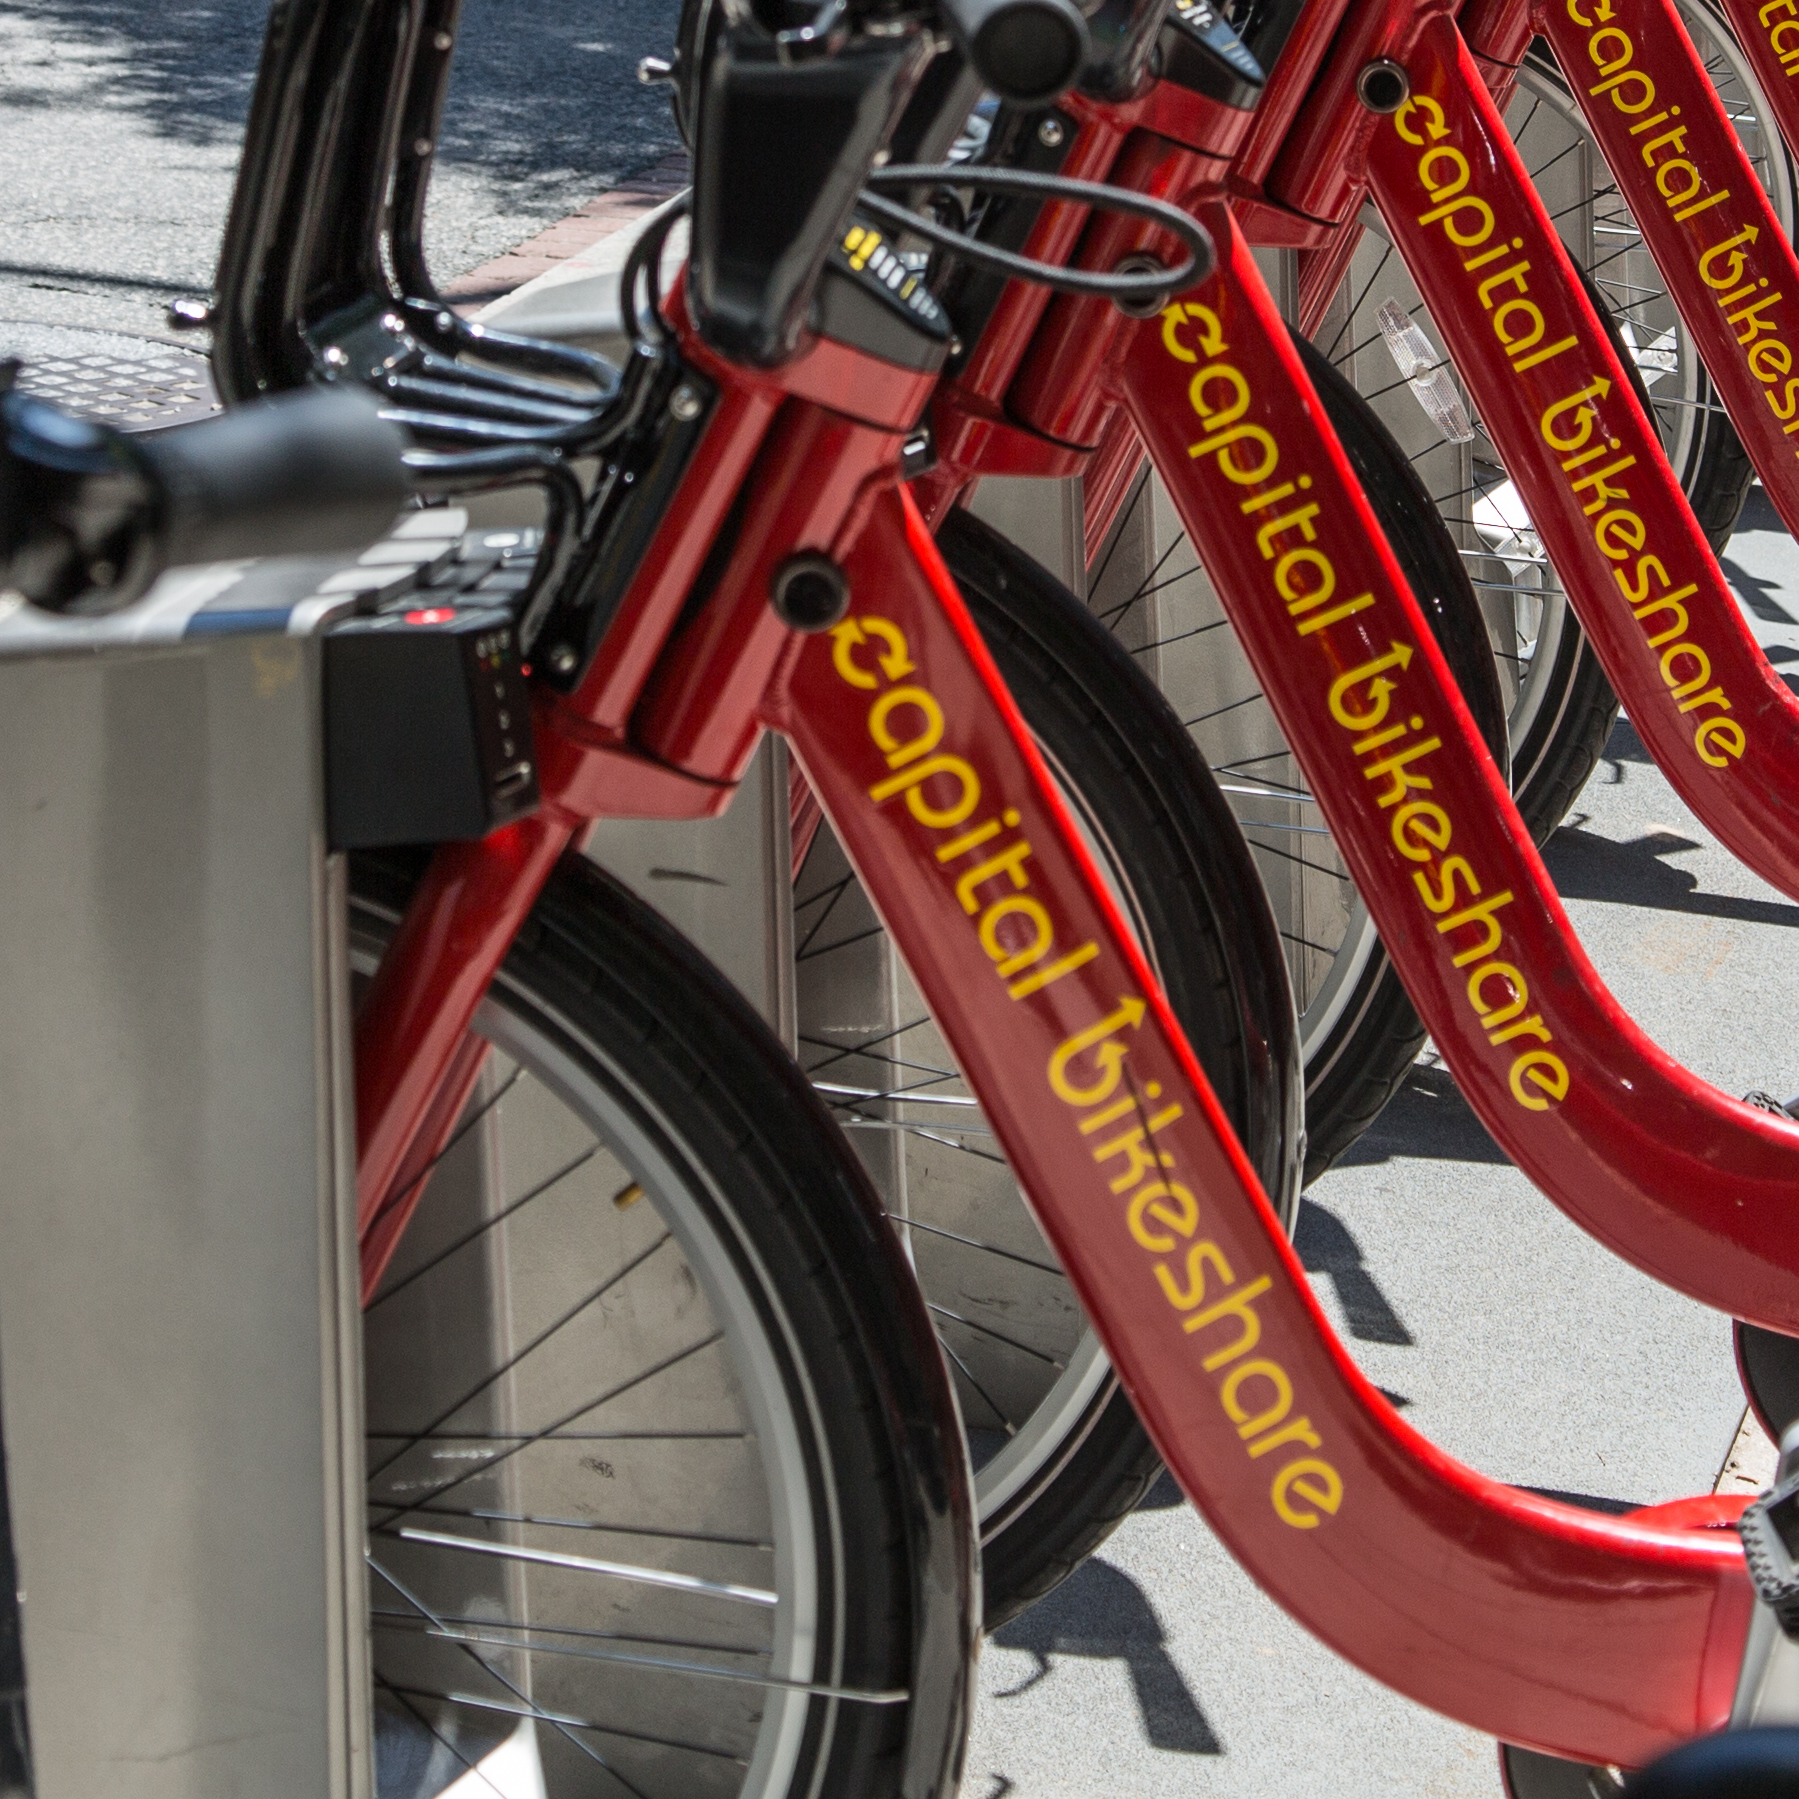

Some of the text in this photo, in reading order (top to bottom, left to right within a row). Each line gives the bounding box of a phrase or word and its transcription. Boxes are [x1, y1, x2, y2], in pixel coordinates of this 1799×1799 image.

[1160, 302, 1570, 1110] capital bikeshare
[1396, 95, 1746, 767] capital bikeshare
[830, 616, 1343, 1530] capital bikeshare
